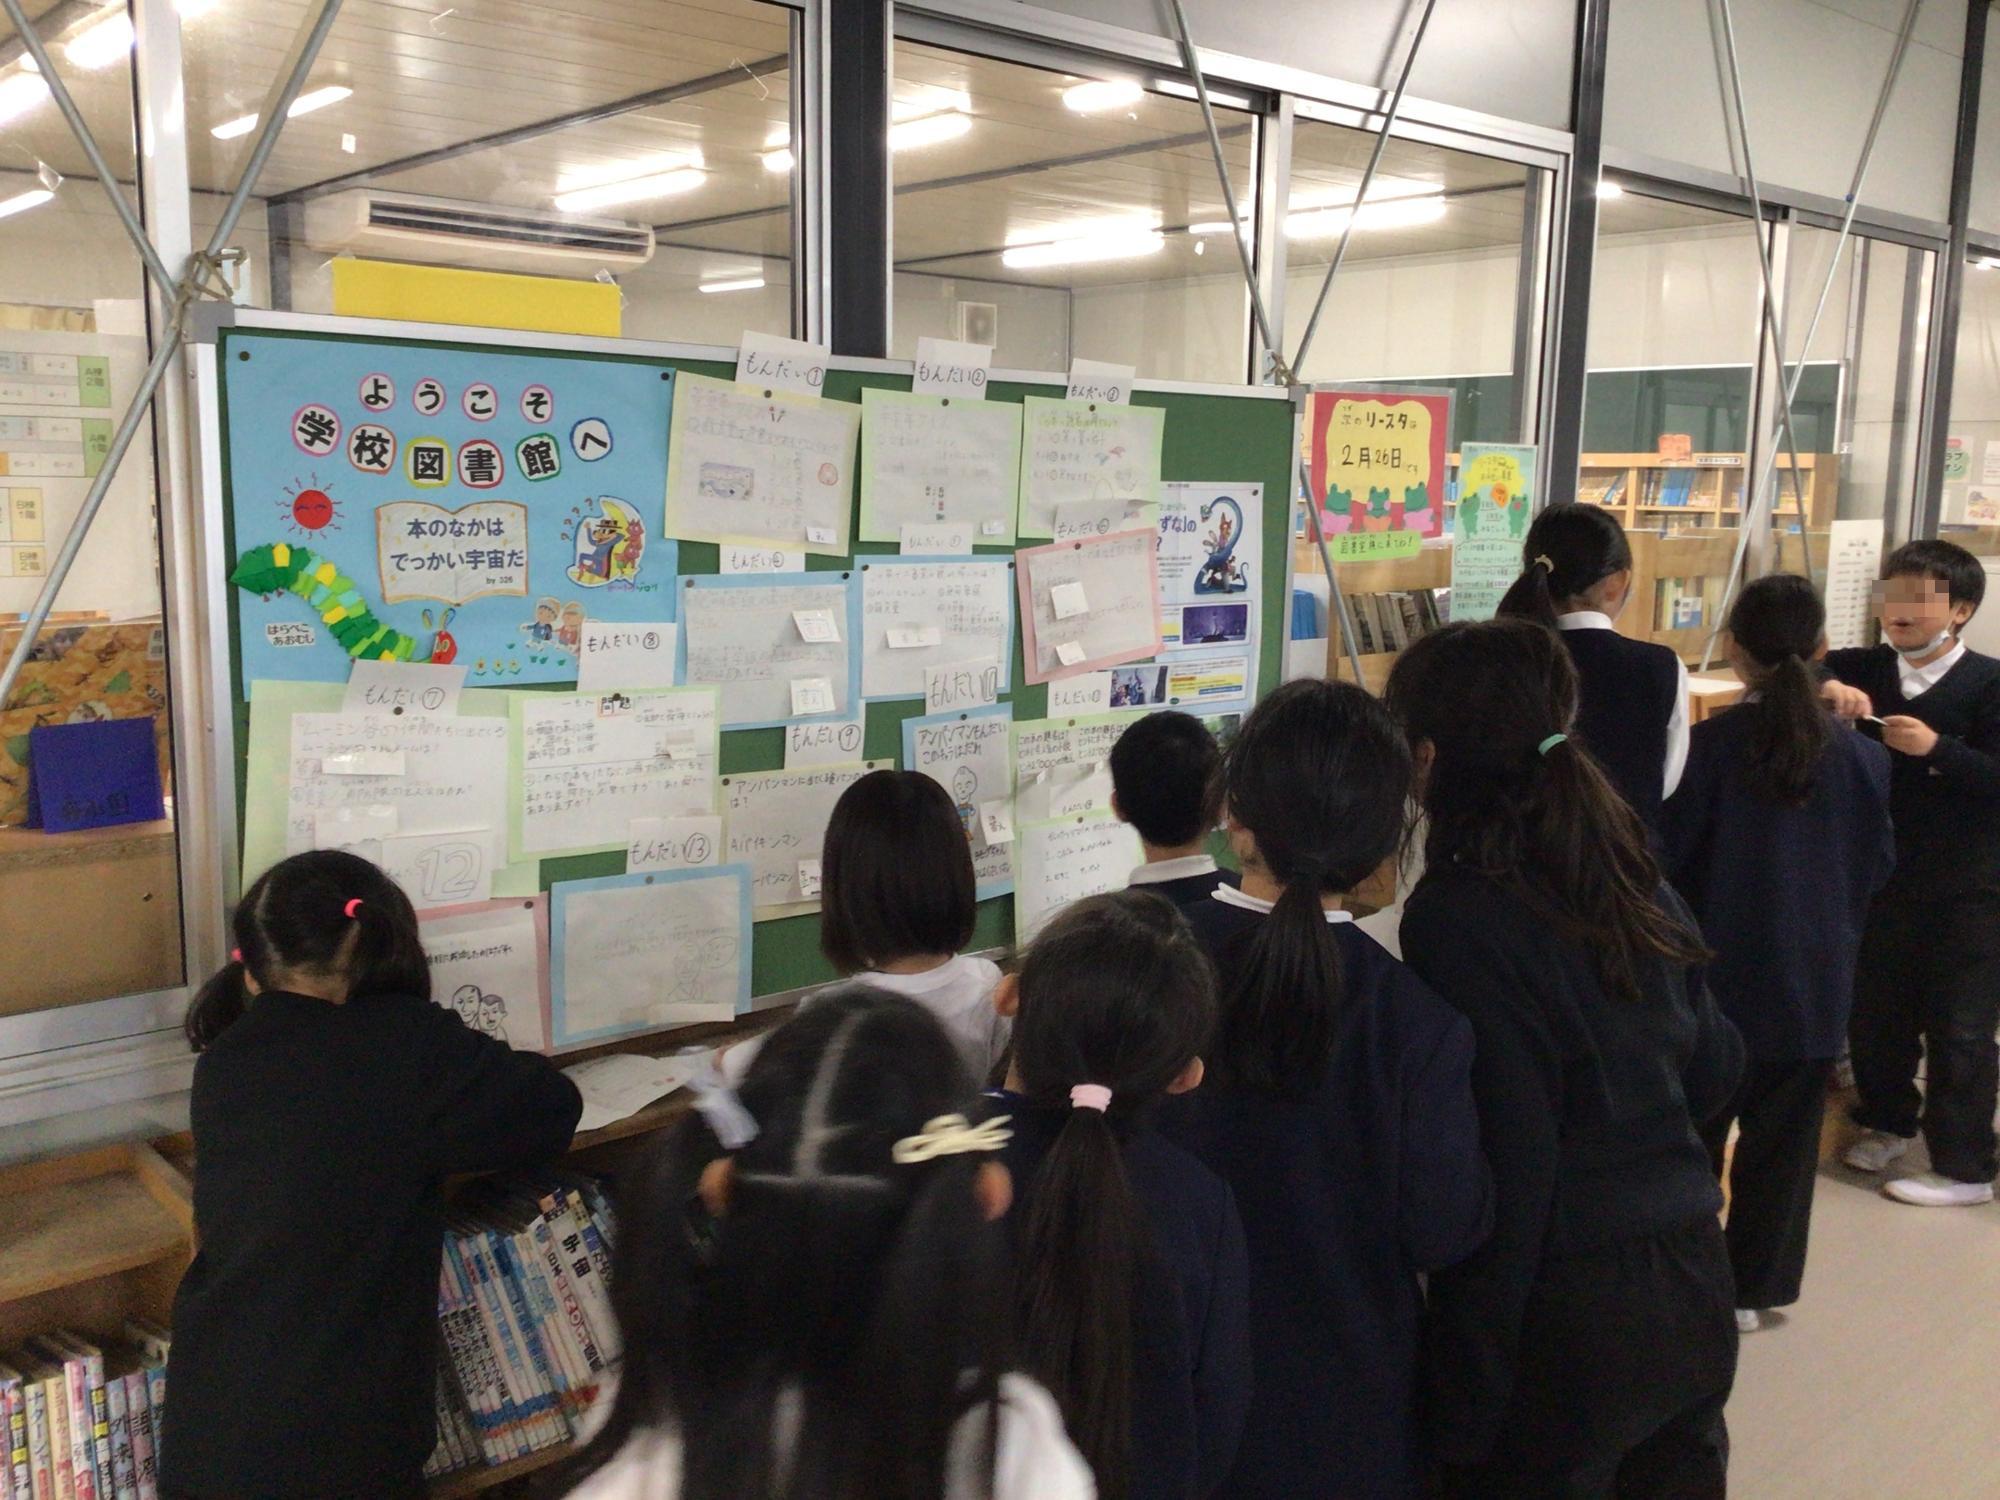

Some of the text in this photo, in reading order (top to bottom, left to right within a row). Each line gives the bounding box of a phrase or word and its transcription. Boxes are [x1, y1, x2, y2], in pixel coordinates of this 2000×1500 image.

[364, 378, 549, 419] ようこそ
[297, 410, 608, 483] 学校図書館へ
[407, 518, 504, 539] 本のなかは
[390, 549, 524, 571] でっかい宇宙だ
[273, 634, 314, 646] あおむし
